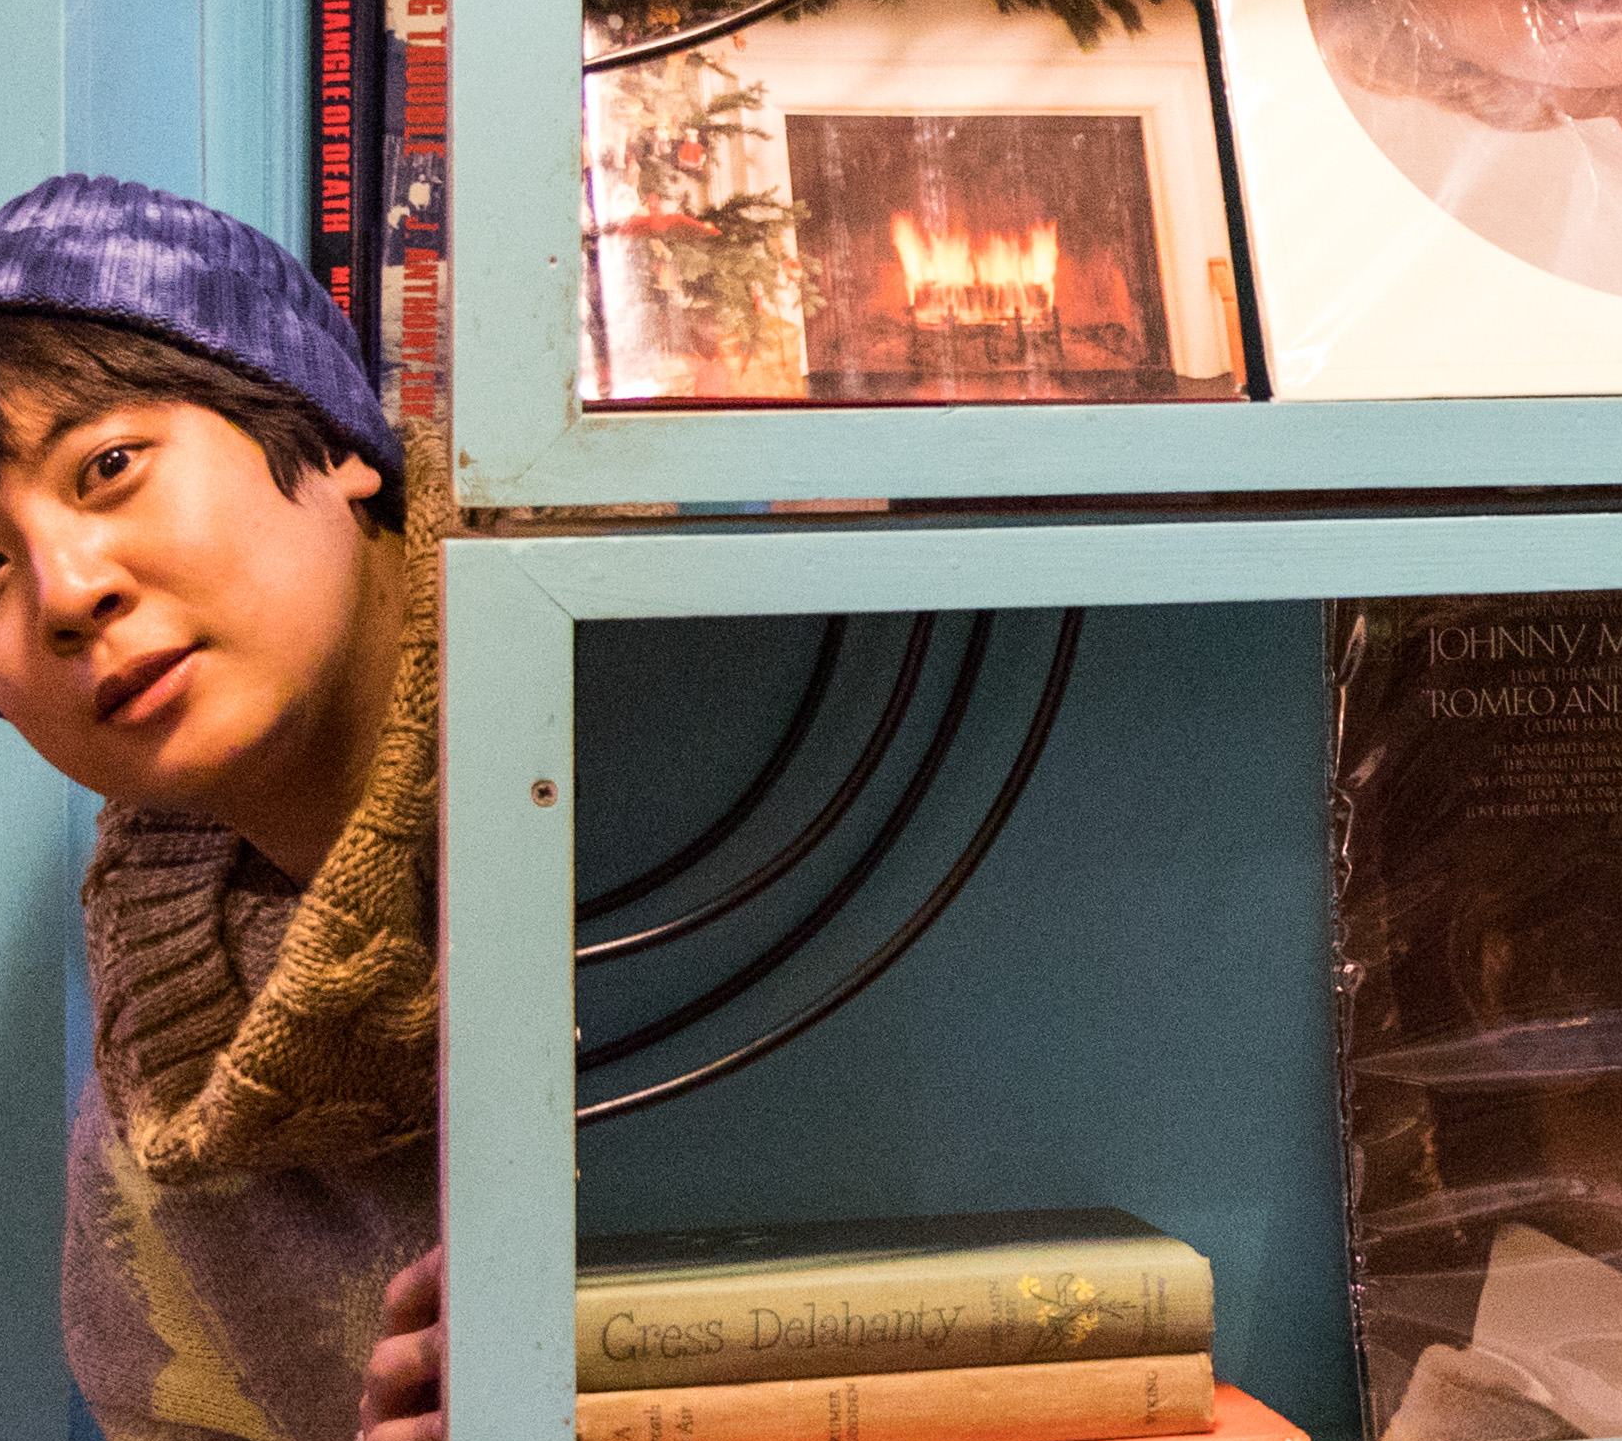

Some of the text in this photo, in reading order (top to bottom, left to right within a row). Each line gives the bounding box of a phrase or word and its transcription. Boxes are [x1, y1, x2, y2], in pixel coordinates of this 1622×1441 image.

[322, 104, 351, 139] OF
[322, 142, 351, 234] DEATH
[1429, 623, 1587, 668] JOHNNY
[600, 1300, 964, 1363] Cress Delahanty
